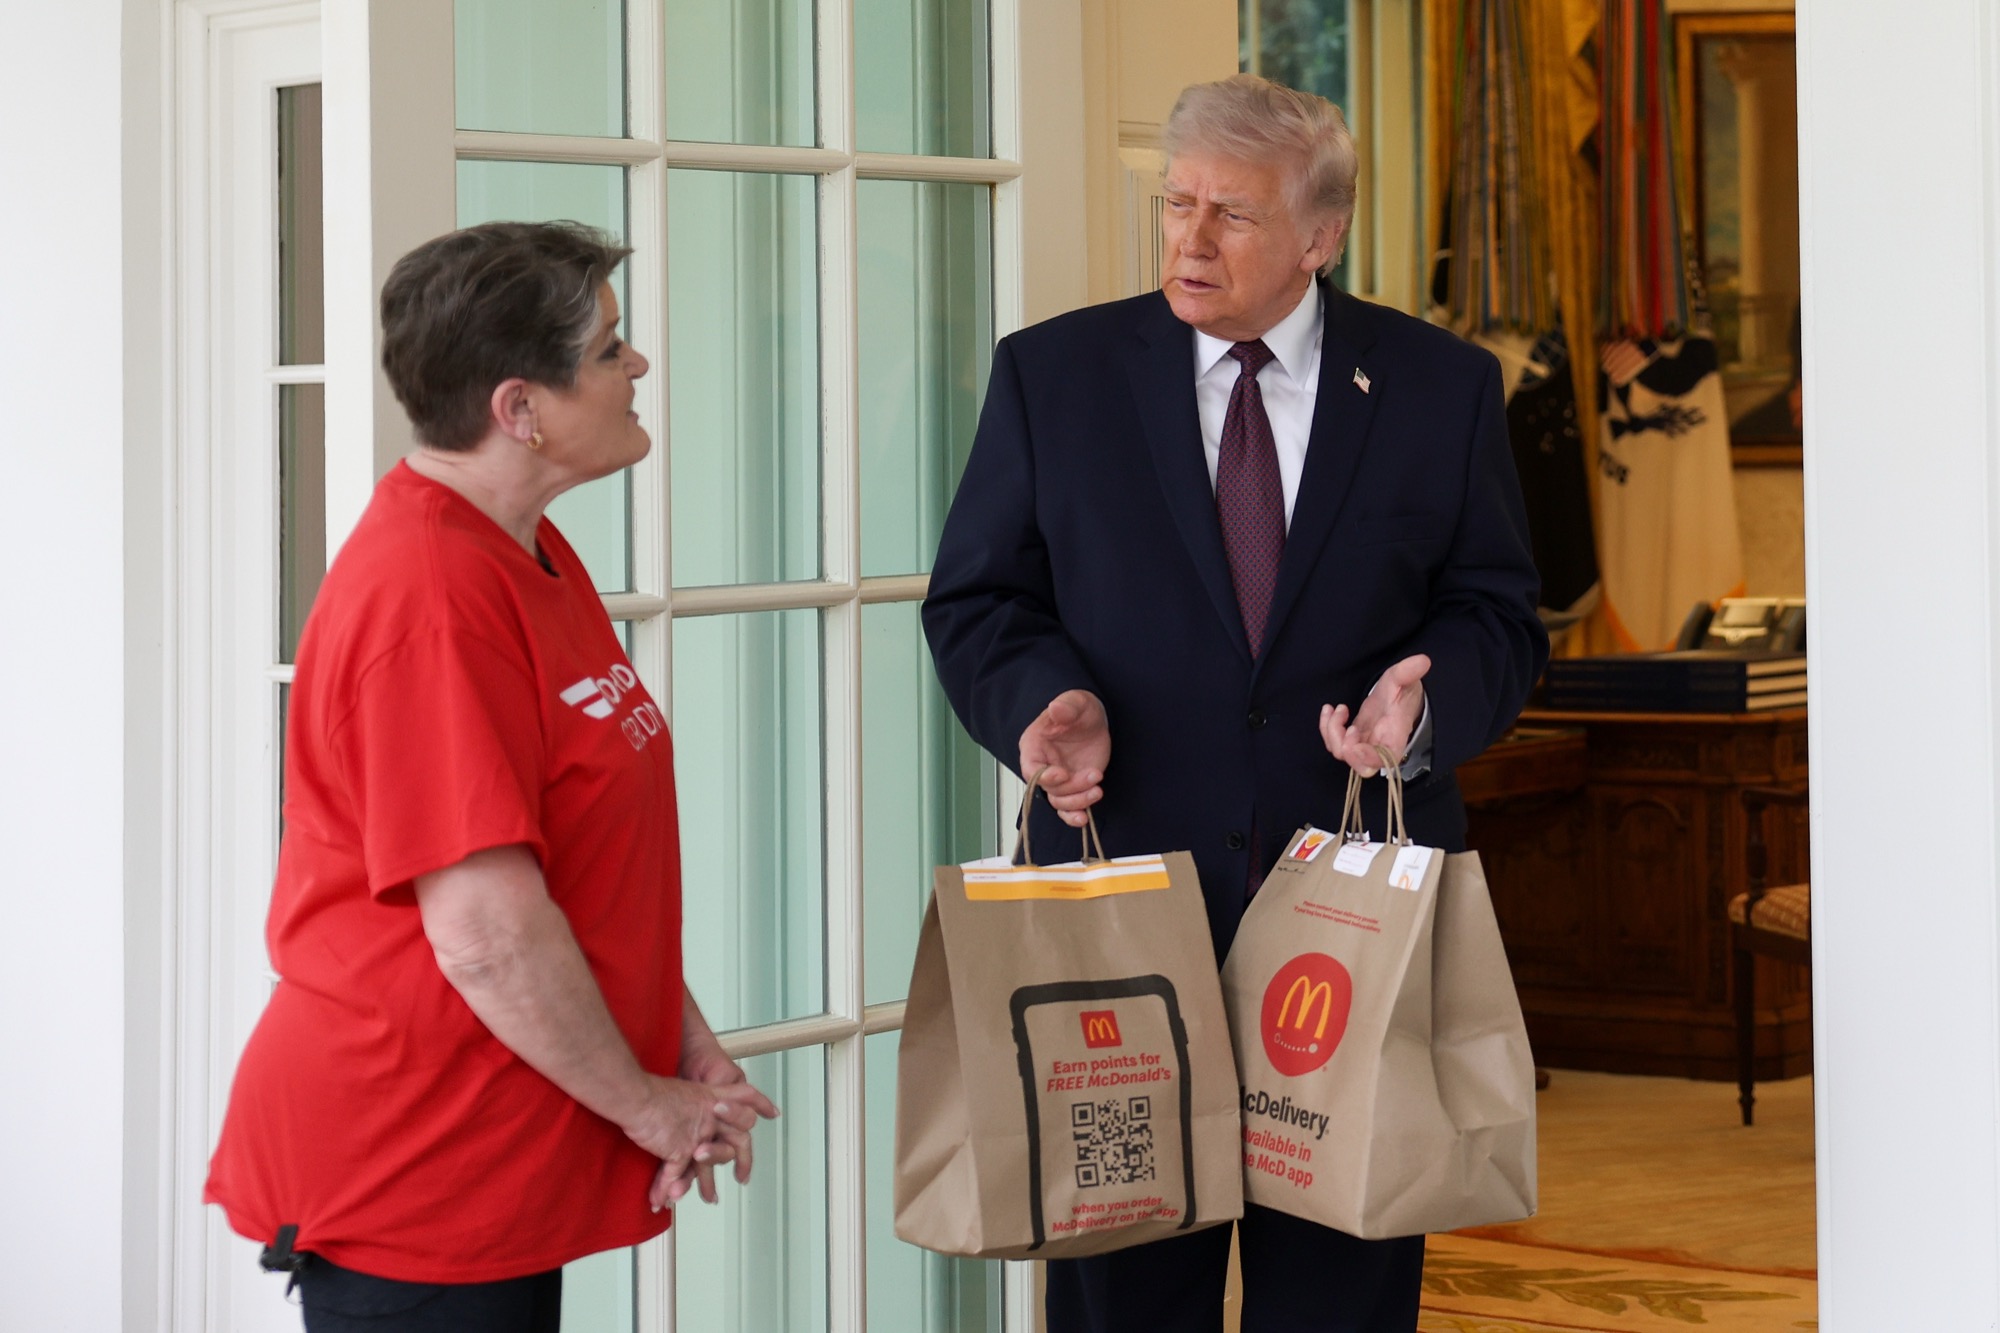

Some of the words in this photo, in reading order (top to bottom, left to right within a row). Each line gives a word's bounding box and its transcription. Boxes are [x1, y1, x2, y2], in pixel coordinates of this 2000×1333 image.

[1053, 1061, 1087, 1075] Earn
[1091, 1055, 1138, 1074] points
[1139, 1052, 1161, 1066] for
[1046, 1075, 1085, 1092] FREE
[1087, 1067, 1172, 1088] McDonald's
[1298, 1141, 1312, 1162] in
[1256, 1153, 1286, 1177] McD
[1287, 1166, 1314, 1189] app
[1072, 1202, 1105, 1216] when
[1107, 1202, 1129, 1215] you
[1131, 1196, 1163, 1208] order
[1052, 1213, 1118, 1233] McDelivery
[1119, 1213, 1134, 1223] on
[1154, 1207, 1179, 1219] app
